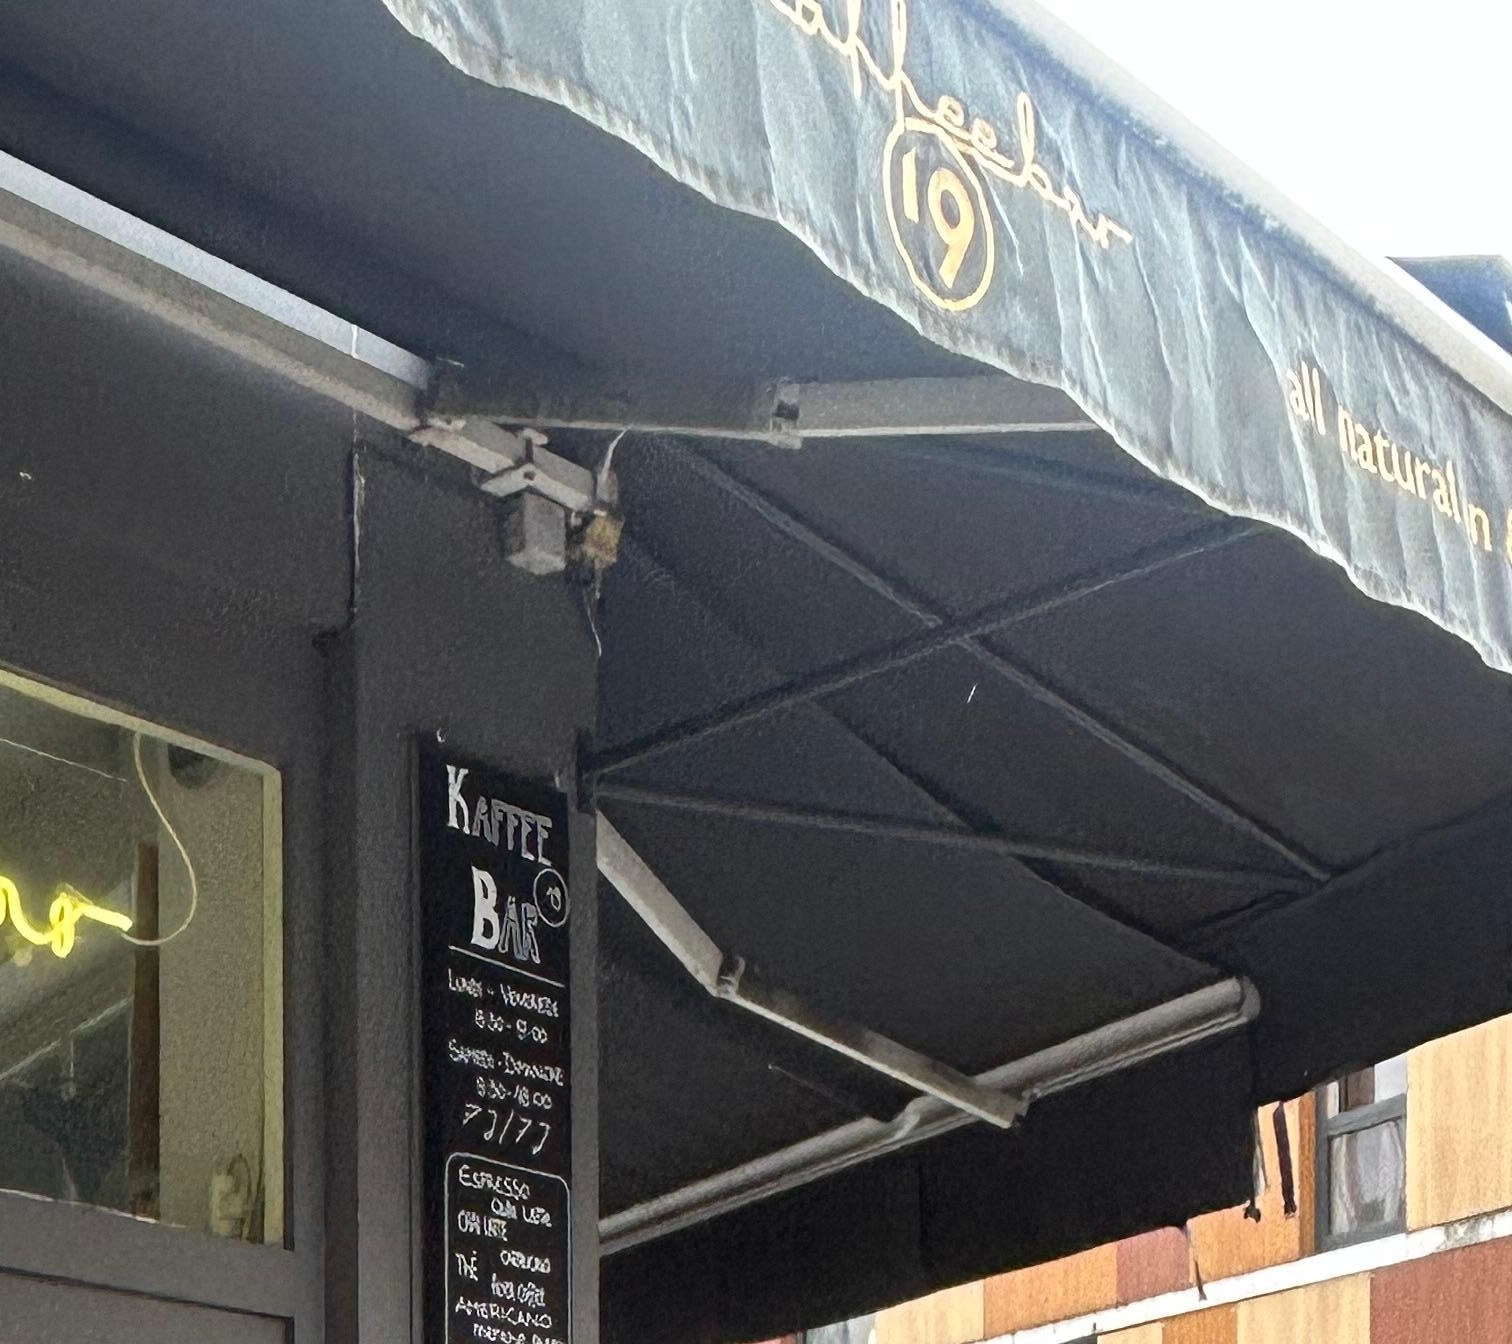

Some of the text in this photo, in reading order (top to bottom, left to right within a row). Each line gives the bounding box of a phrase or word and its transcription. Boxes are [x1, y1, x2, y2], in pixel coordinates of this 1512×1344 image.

[902, 147, 975, 289] 19
[1288, 360, 1326, 436] all
[1338, 405, 1461, 524] natural
[446, 764, 553, 867] KAFFEE
[471, 865, 541, 964] BAR
